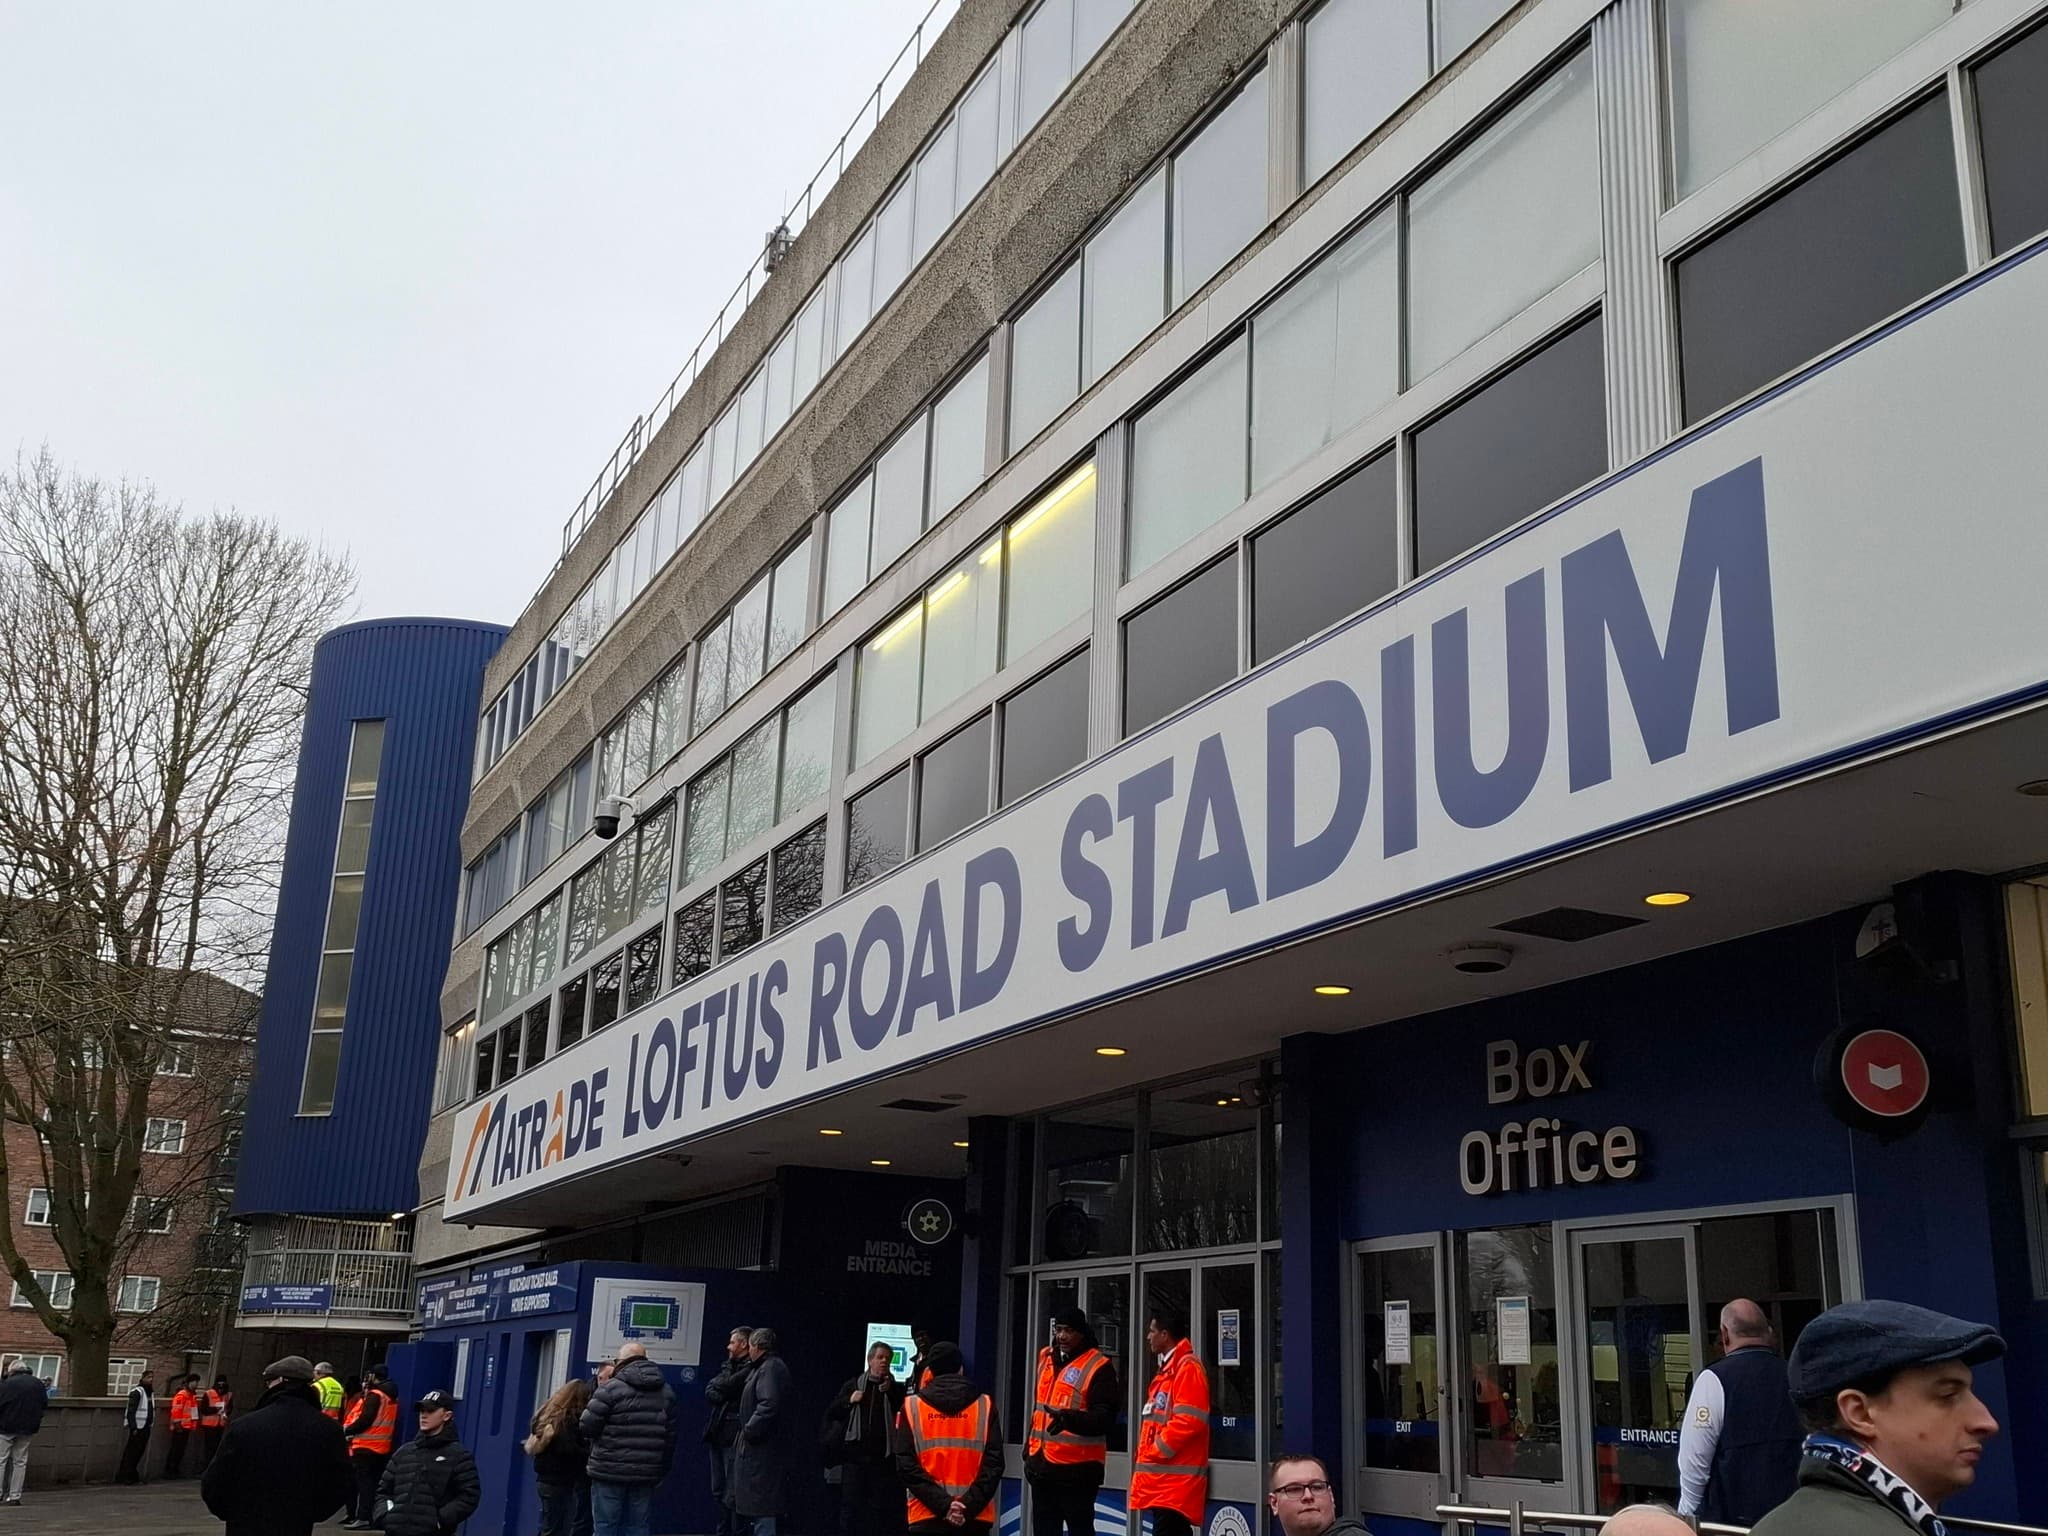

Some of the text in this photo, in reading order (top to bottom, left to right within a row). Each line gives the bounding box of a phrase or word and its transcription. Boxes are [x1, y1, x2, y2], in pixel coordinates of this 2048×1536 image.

[454, 455, 1781, 1201] MATRADE LOFTUS ROAD STADIUM
[1459, 1117, 1637, 1195] Office
[865, 1239, 917, 1259] MEDIA
[847, 1255, 932, 1277] ENTRANCE
[1223, 1416, 1236, 1427] EXIT
[1396, 1421, 1412, 1432] EXIT
[1621, 1428, 1678, 1444] ENTRANCE
